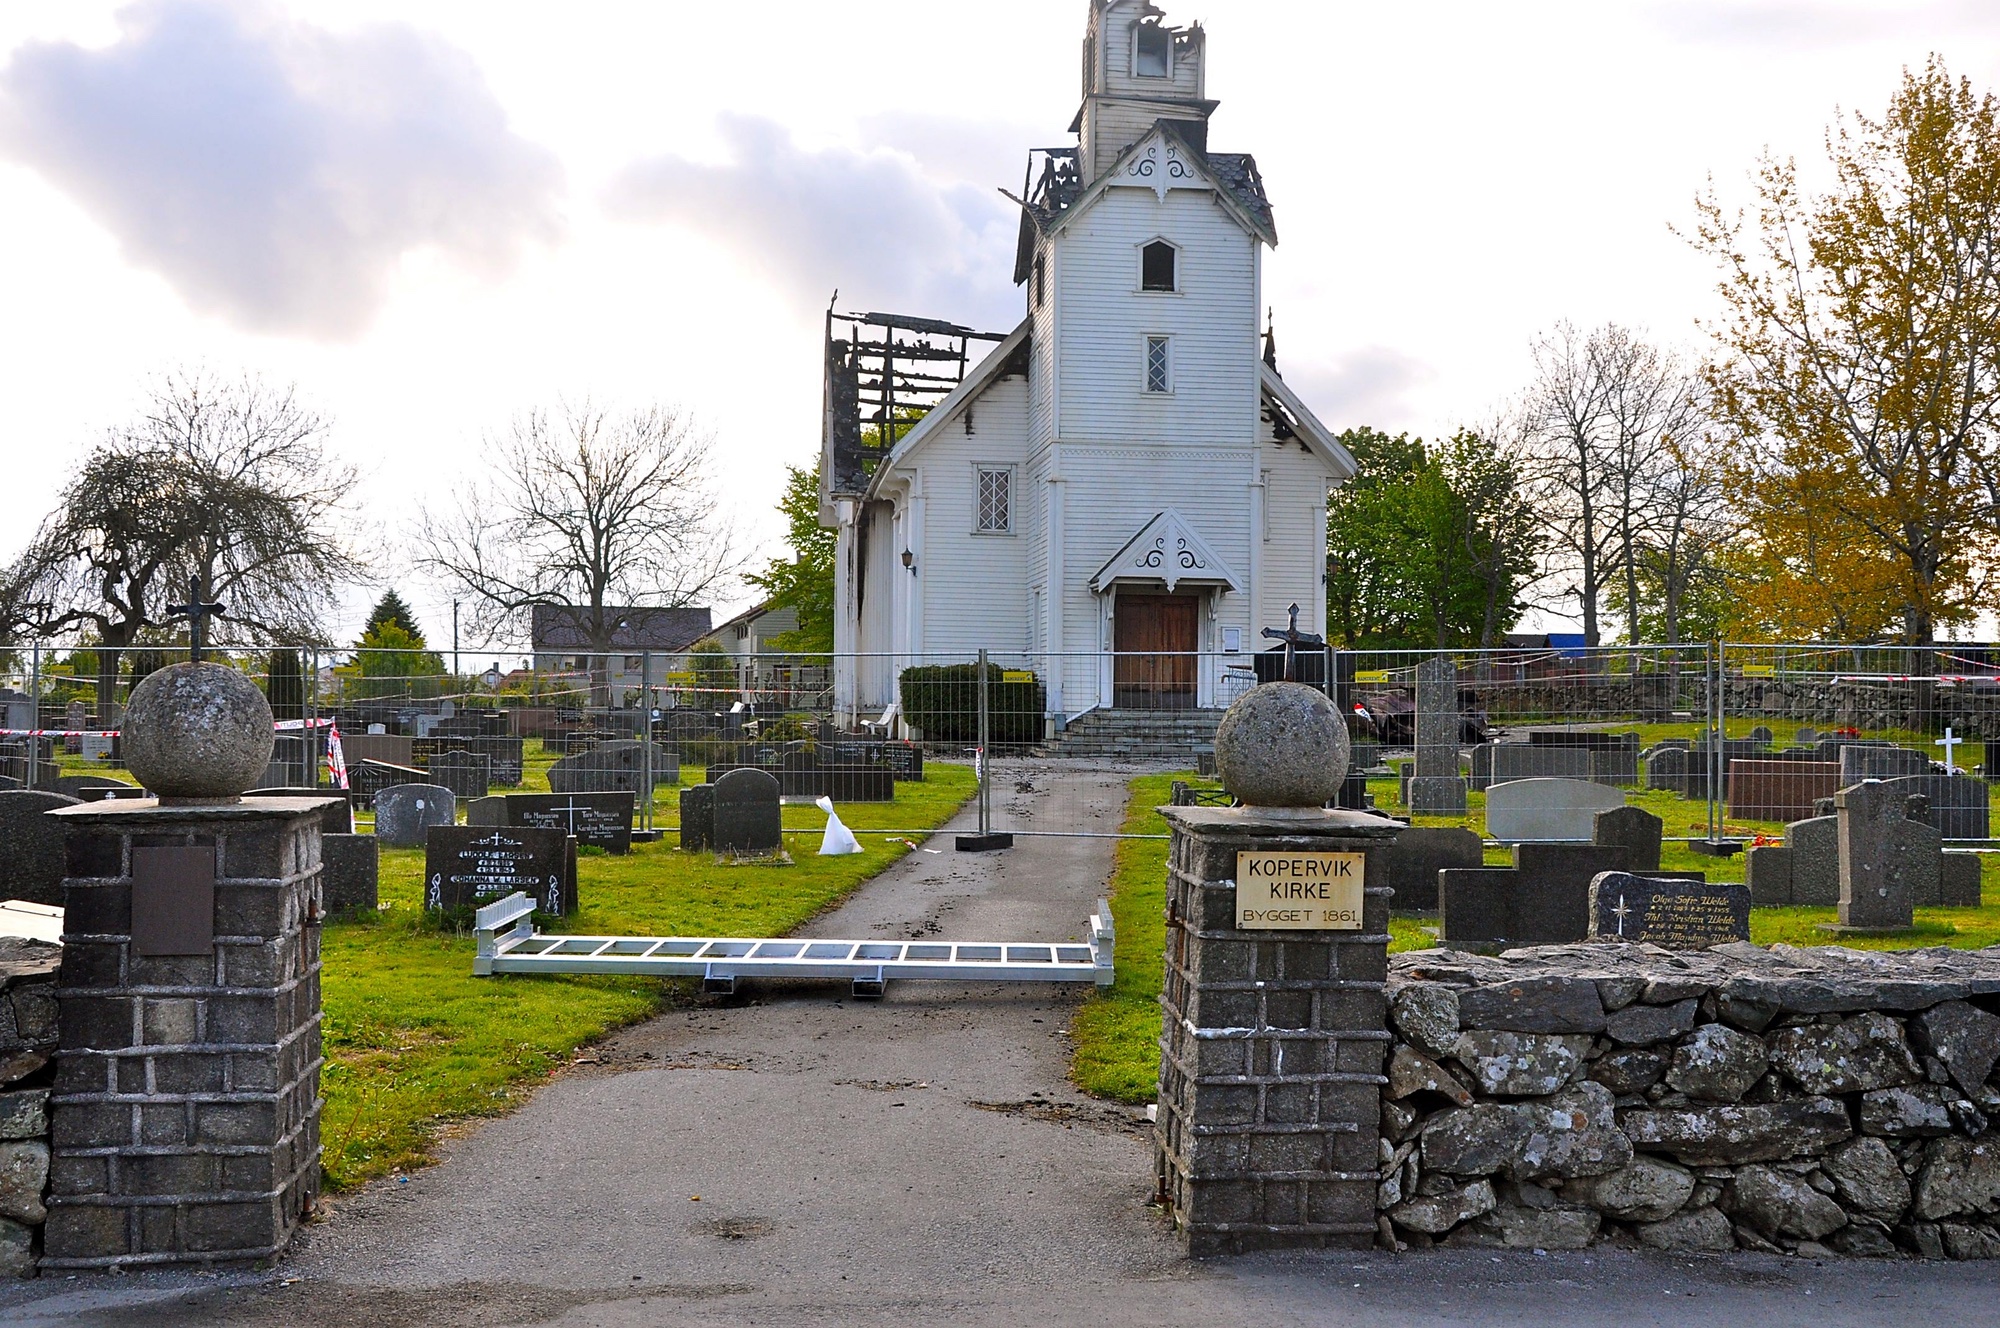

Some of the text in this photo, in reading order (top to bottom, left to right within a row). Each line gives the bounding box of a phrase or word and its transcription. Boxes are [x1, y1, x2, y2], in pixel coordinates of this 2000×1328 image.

[1249, 859, 1352, 877] KOPERVIK
[453, 875, 490, 883] JOHANNA
[504, 876, 537, 884] LARSEN
[1270, 882, 1331, 899] KIRKE
[1652, 894, 1730, 906] Olga Sofie Welde
[1243, 909, 1356, 921] BYGGET 1861
[1707, 914, 1736, 925] Welde
